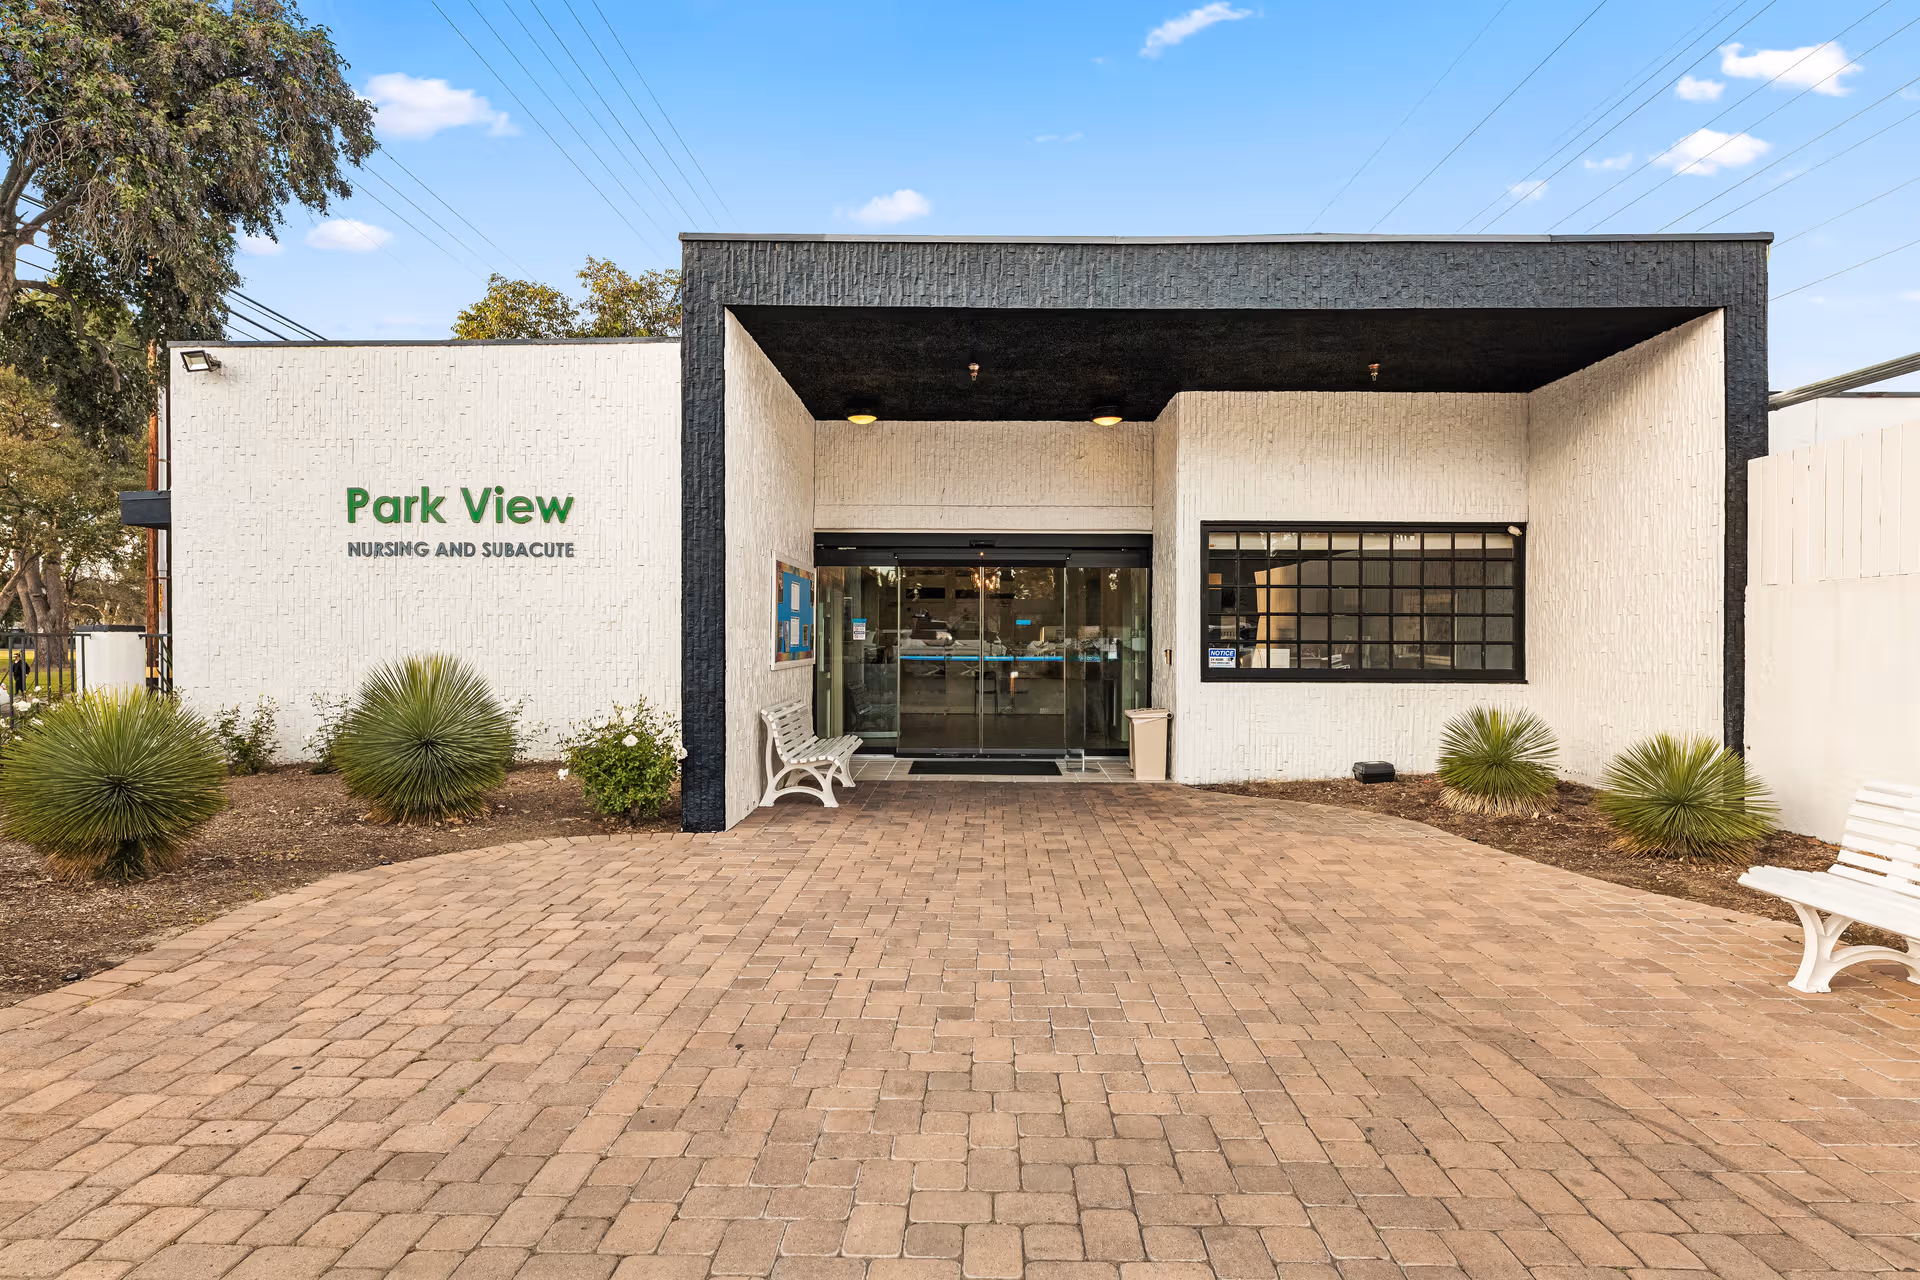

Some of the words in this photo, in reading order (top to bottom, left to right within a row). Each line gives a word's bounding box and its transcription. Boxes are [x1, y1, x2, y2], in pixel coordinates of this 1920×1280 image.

[346, 486, 446, 523] Park
[460, 485, 574, 524] View
[347, 541, 430, 558] NURSING
[435, 541, 477, 558] AND
[481, 541, 575, 558] SUBACUTE
